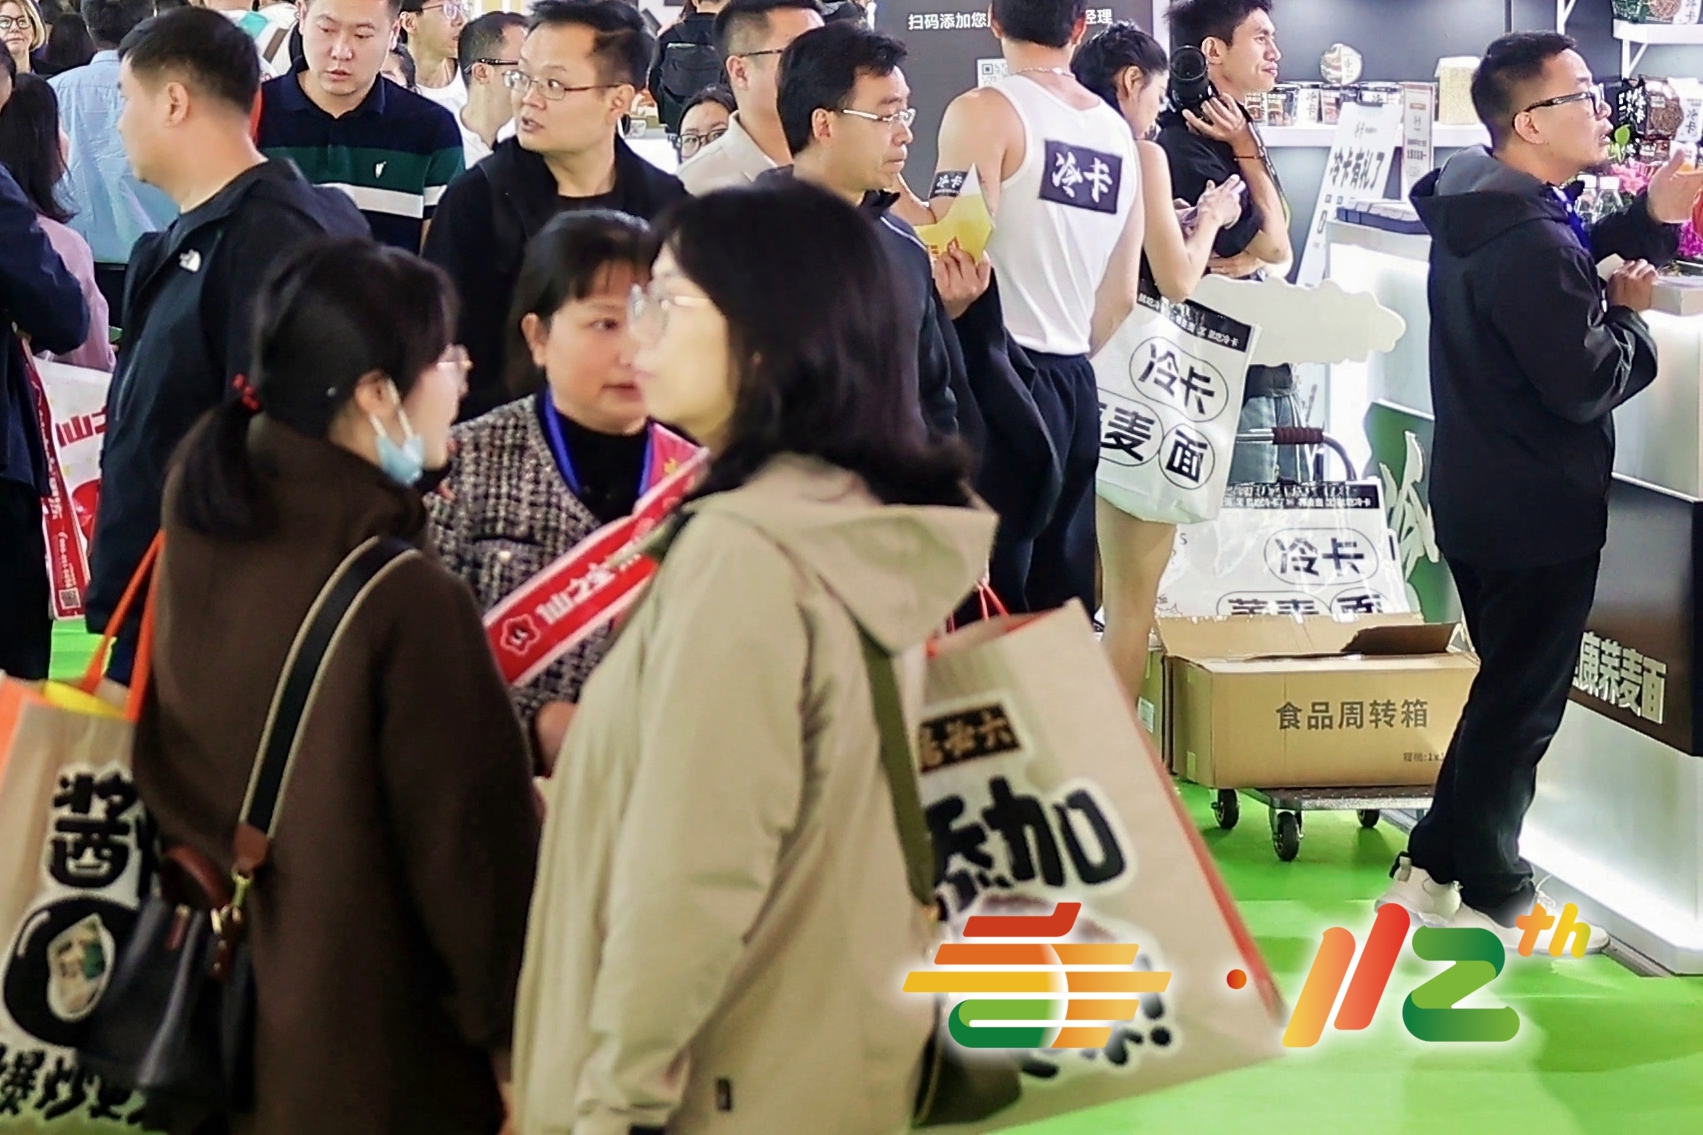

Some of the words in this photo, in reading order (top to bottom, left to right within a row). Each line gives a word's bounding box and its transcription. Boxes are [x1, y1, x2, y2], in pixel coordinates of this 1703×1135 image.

[907, 11, 992, 31] 扫码添加您
[1051, 152, 1113, 203] 冷卡
[1138, 345, 1215, 416] 冷卡
[1275, 537, 1365, 577] 冷卡
[1572, 631, 1668, 725] 康荞麦面
[1275, 699, 1430, 731] 食品周转箱
